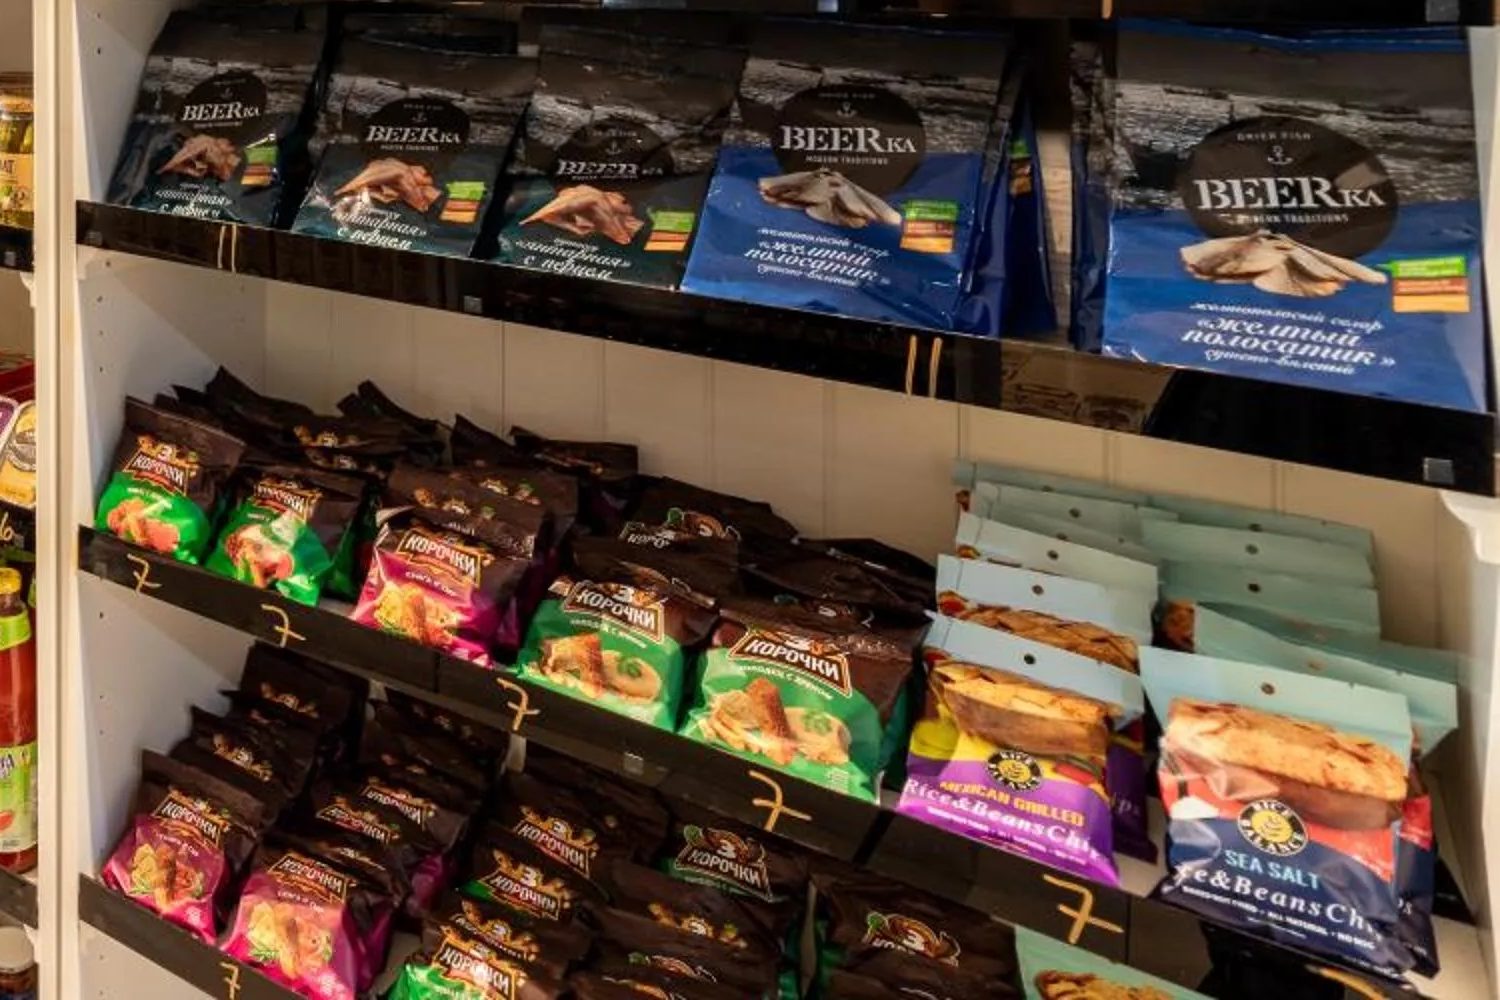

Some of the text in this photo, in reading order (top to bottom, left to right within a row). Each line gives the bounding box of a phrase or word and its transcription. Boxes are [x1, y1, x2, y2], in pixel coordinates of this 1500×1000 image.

[779, 125, 918, 154] BEERKA
[1193, 176, 1387, 211] BEERKA
[904, 333, 943, 400] 11
[126, 553, 162, 595] 7
[404, 533, 479, 578] КОРОЧКИ
[260, 603, 306, 648] 7
[576, 588, 656, 628] КОРОЧКИ
[744, 638, 840, 682] КОРОЧКИ
[496, 677, 541, 731] 7
[160, 801, 218, 839] КОРОЧКИ
[748, 769, 813, 832] 7
[1012, 796, 1086, 828] GRILLED
[519, 823, 586, 869] КОРОЧКИ
[687, 847, 762, 887] КОРОЧКИ
[279, 858, 344, 893] КОРОЧКИ
[1224, 849, 1321, 891] SEA SALT
[1043, 874, 1124, 945] 7
[219, 961, 242, 999] 7
